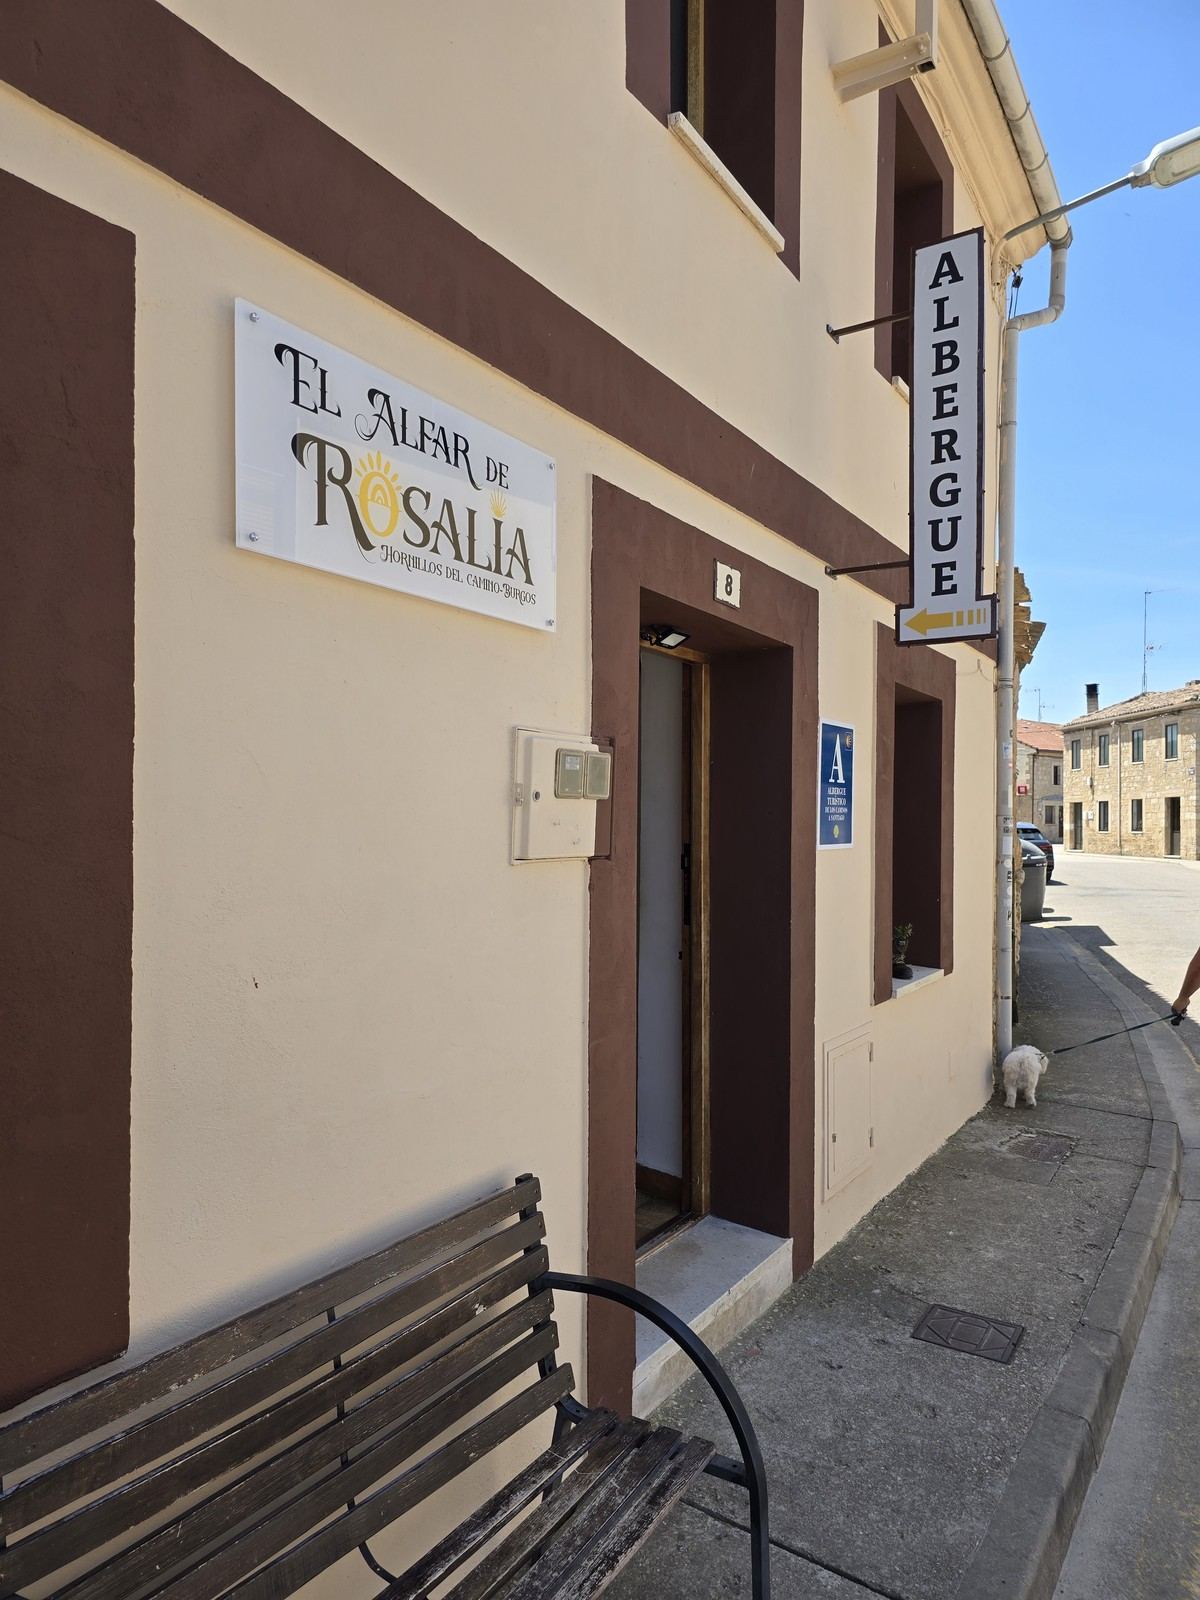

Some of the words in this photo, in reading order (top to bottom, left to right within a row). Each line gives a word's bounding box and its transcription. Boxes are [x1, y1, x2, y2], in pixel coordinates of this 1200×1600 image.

[273, 343, 342, 418] EL
[354, 387, 483, 491] ALFAR
[485, 455, 509, 490] DE
[928, 250, 964, 597] ALBERGUE
[379, 544, 443, 579] HORNILLOS
[445, 566, 464, 584] DEL
[725, 574, 733, 596] 8
[828, 733, 846, 784] A
